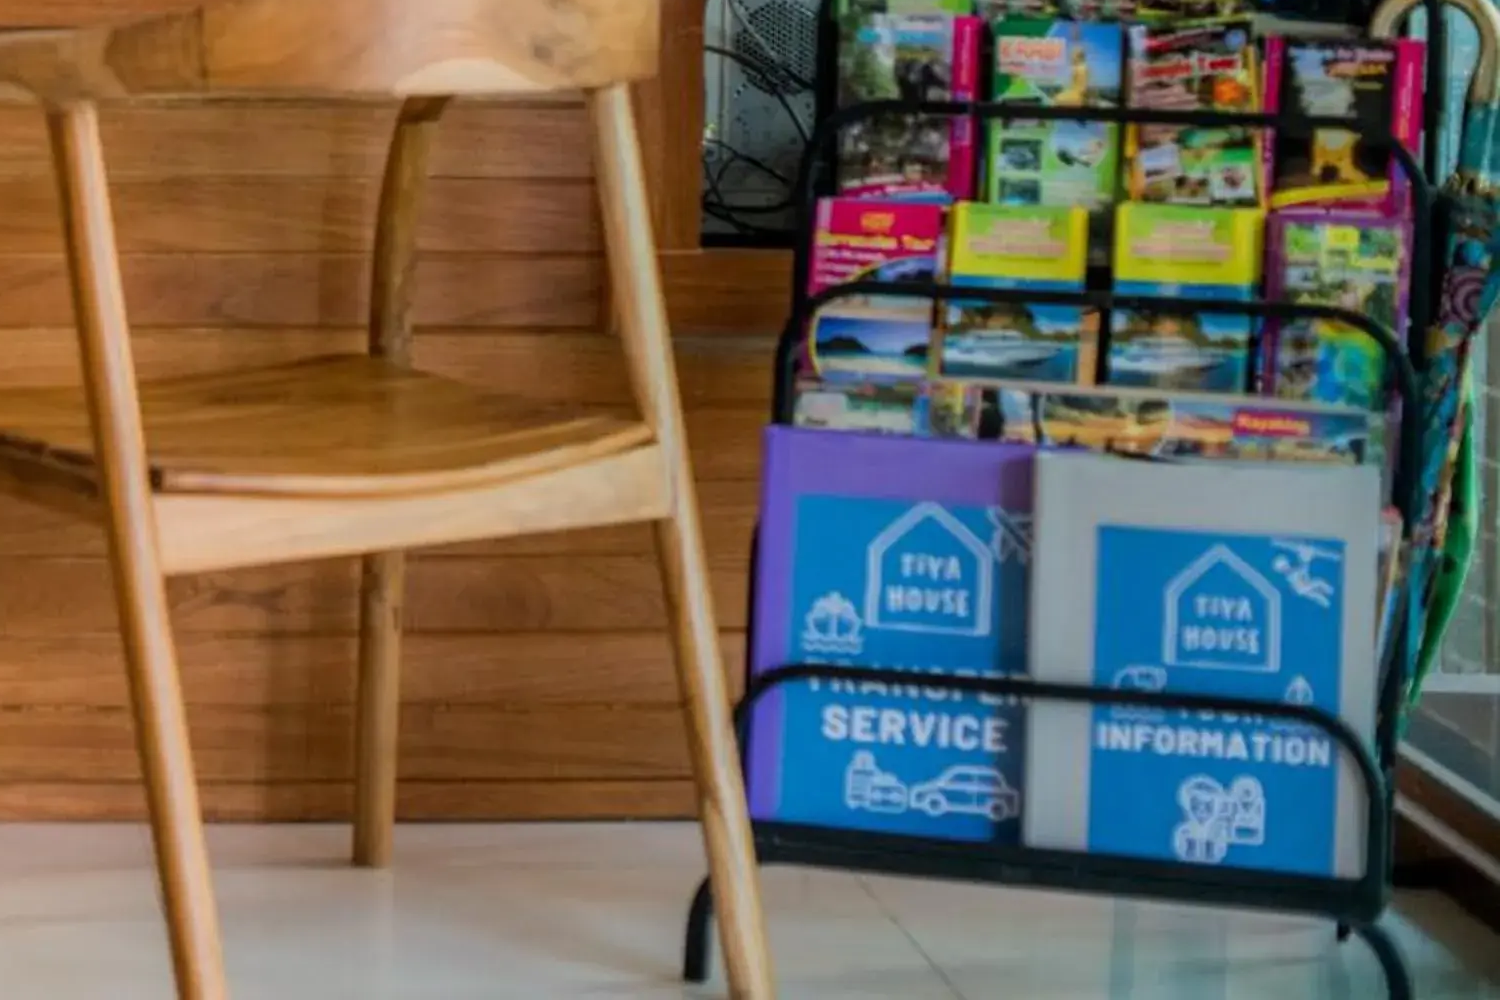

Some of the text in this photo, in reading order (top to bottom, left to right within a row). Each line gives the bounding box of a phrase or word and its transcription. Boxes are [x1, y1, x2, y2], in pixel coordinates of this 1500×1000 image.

[885, 583, 970, 618] HOUSE
[1181, 624, 1260, 655] HOUSE
[821, 703, 1010, 753] SERVICE
[1096, 721, 1331, 767] INFORMATION
